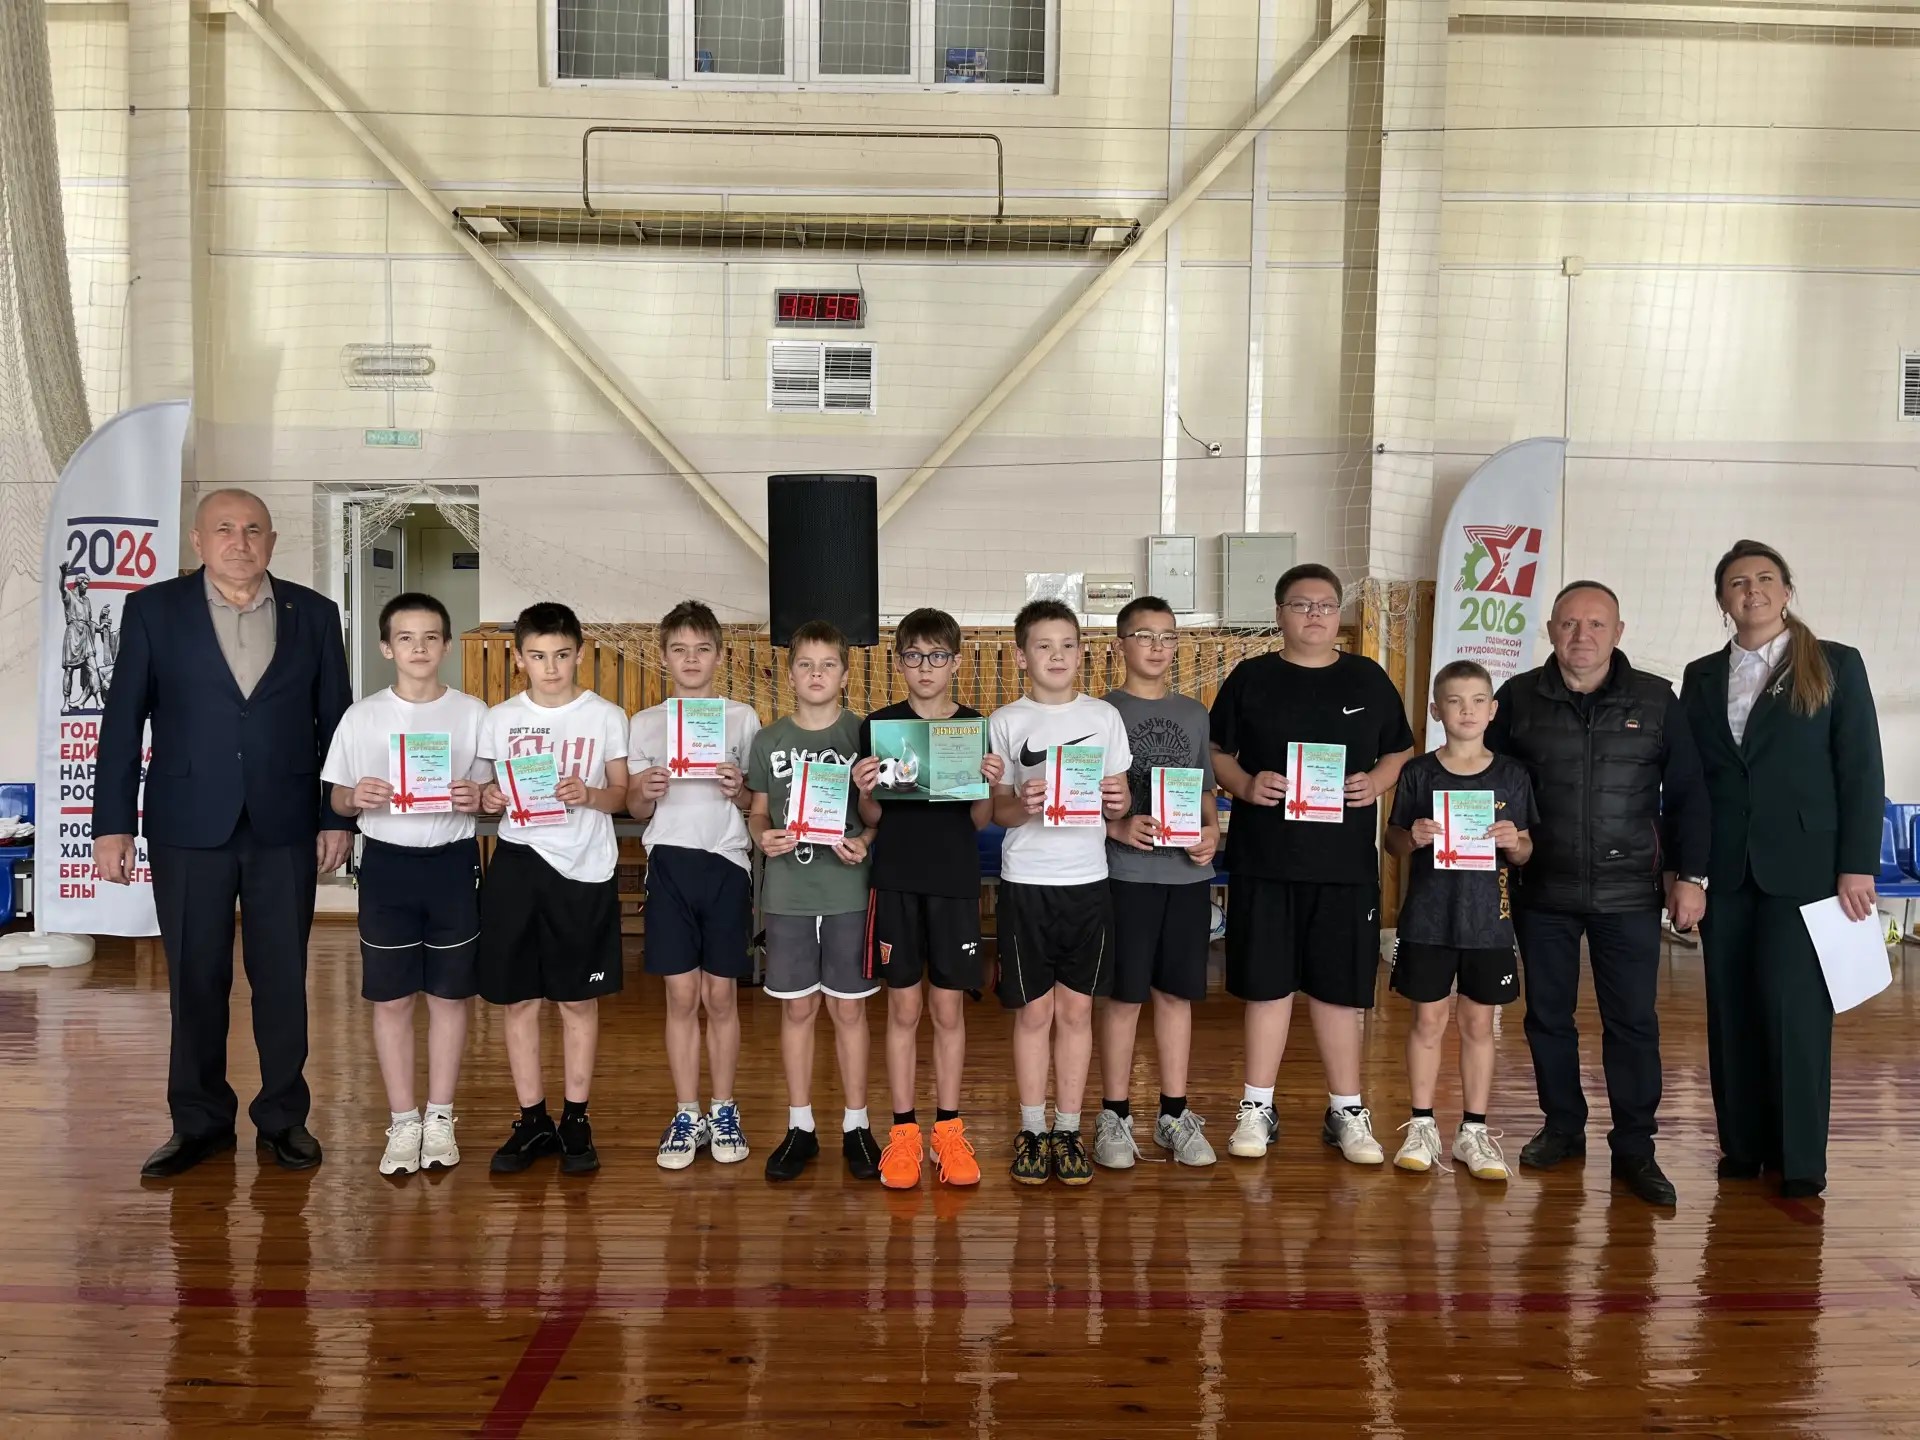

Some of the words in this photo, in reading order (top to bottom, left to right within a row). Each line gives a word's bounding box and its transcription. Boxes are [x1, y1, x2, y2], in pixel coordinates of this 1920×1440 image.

[66, 528, 157, 579] 2026
[1457, 597, 1527, 635] 2026
[1456, 646, 1463, 654] И
[60, 721, 99, 741] ГОД
[509, 727, 530, 735] DON'T
[531, 727, 551, 735] LOSE
[59, 883, 96, 899] ЕЛЫ
[1498, 867, 1511, 920] YONEX
